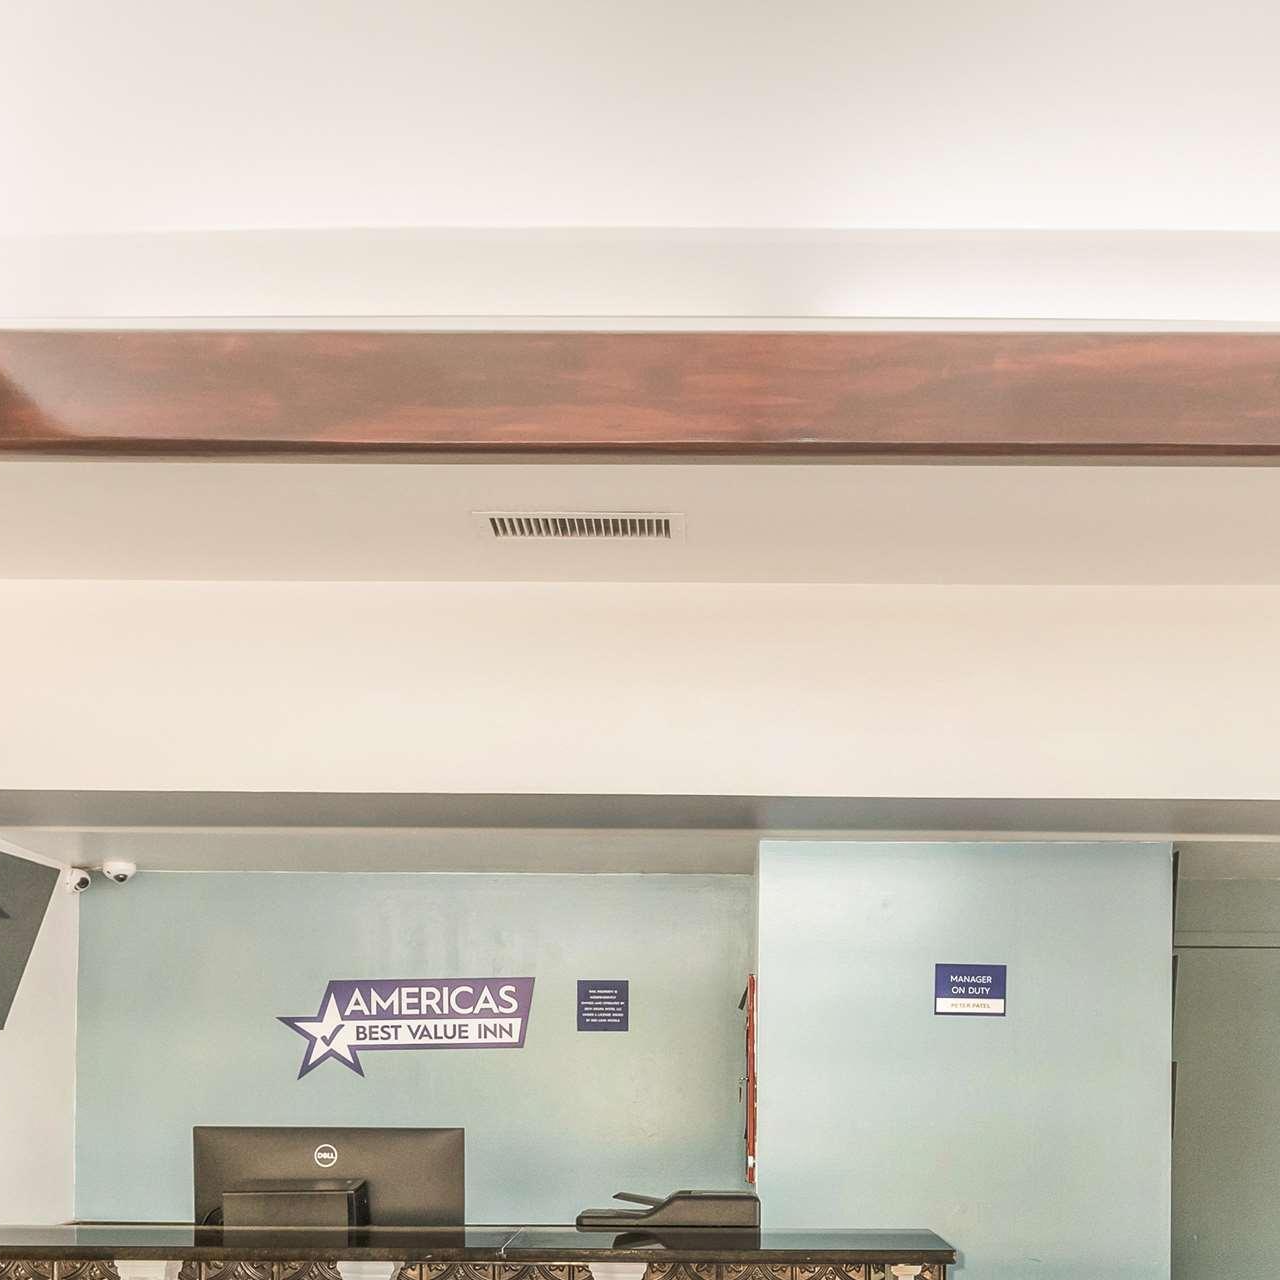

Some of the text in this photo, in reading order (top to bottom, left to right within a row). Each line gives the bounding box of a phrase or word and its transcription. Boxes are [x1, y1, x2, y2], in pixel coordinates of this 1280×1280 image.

[950, 975, 992, 984] MANAGER
[951, 986, 991, 995] ON DUTY
[344, 985, 519, 1016] AMERICAS
[355, 1023, 513, 1041] BEST VALUE INN
